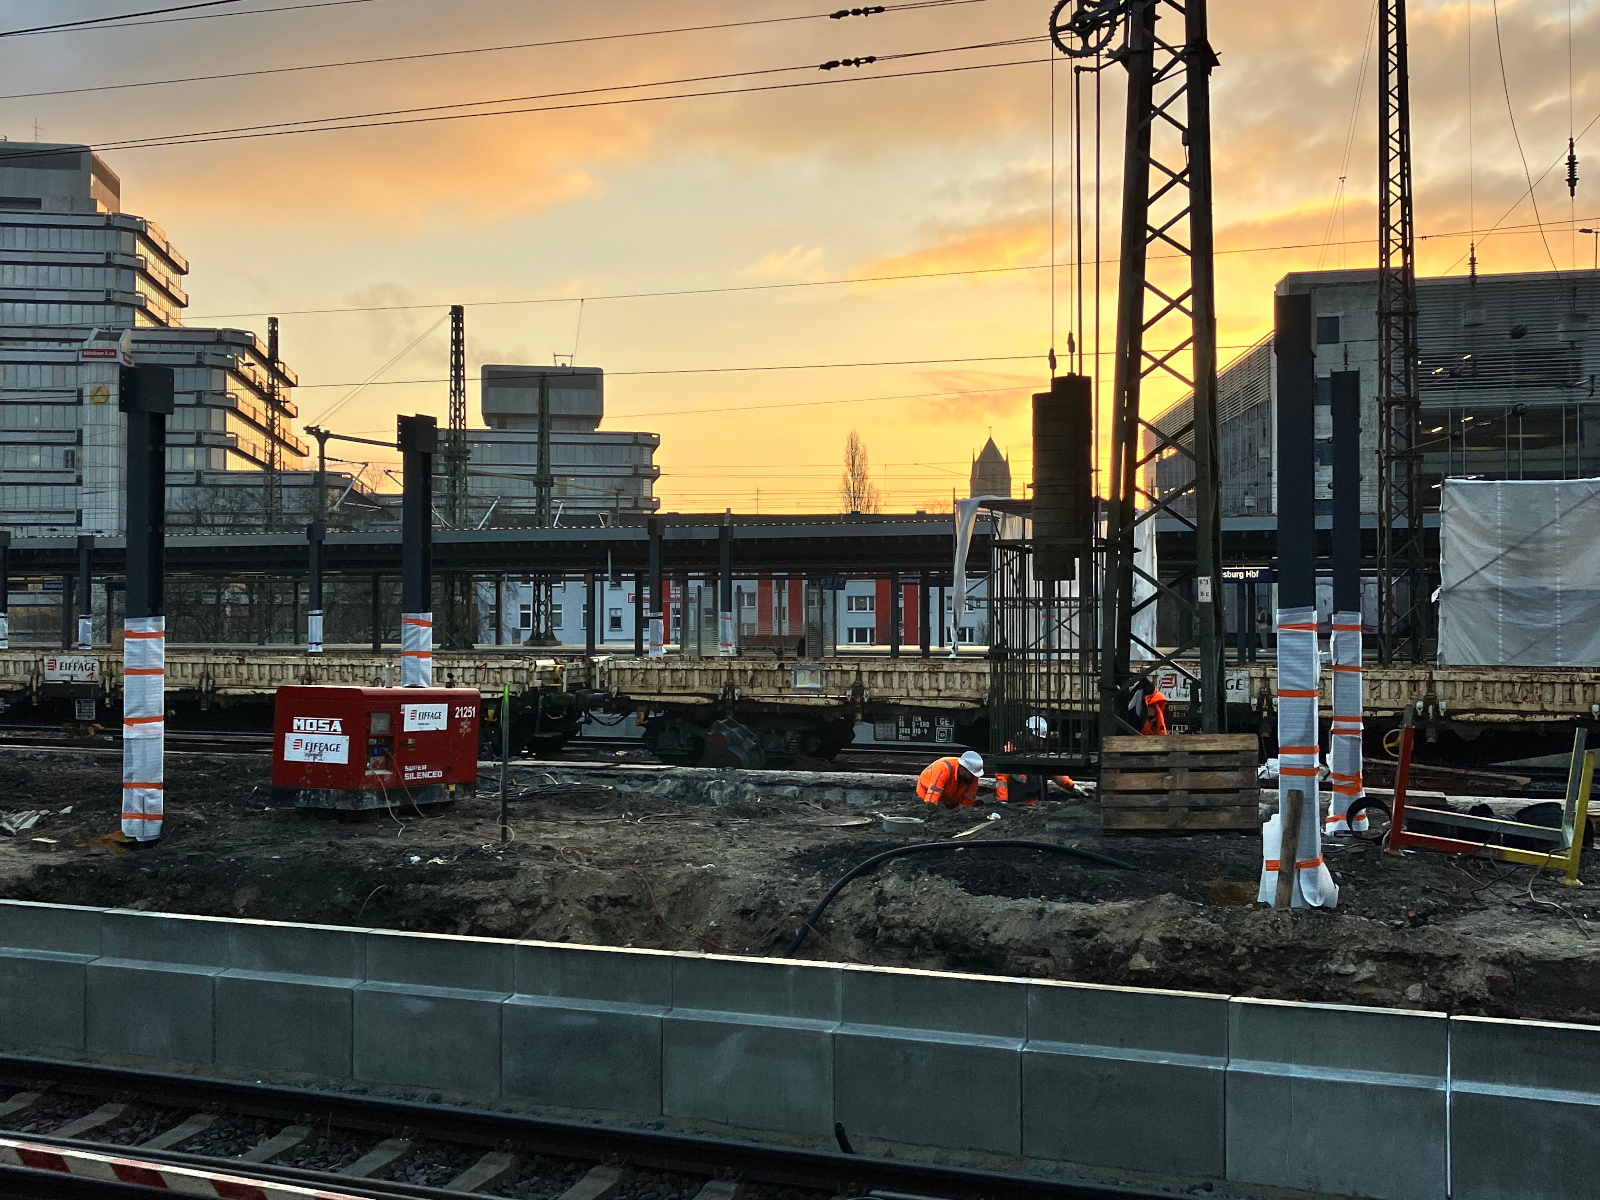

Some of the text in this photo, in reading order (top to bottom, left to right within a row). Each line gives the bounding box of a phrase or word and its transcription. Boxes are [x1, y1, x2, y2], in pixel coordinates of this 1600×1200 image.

[1222, 569, 1260, 580] sburg Hbf
[59, 661, 96, 672] EIFFAGE
[418, 711, 442, 721] EIFFAGE
[454, 706, 476, 719] 21251
[293, 719, 342, 732] MOSA
[304, 741, 342, 753] EIFFAGE
[404, 764, 428, 772] SUPER
[404, 771, 443, 781] SILENCED
